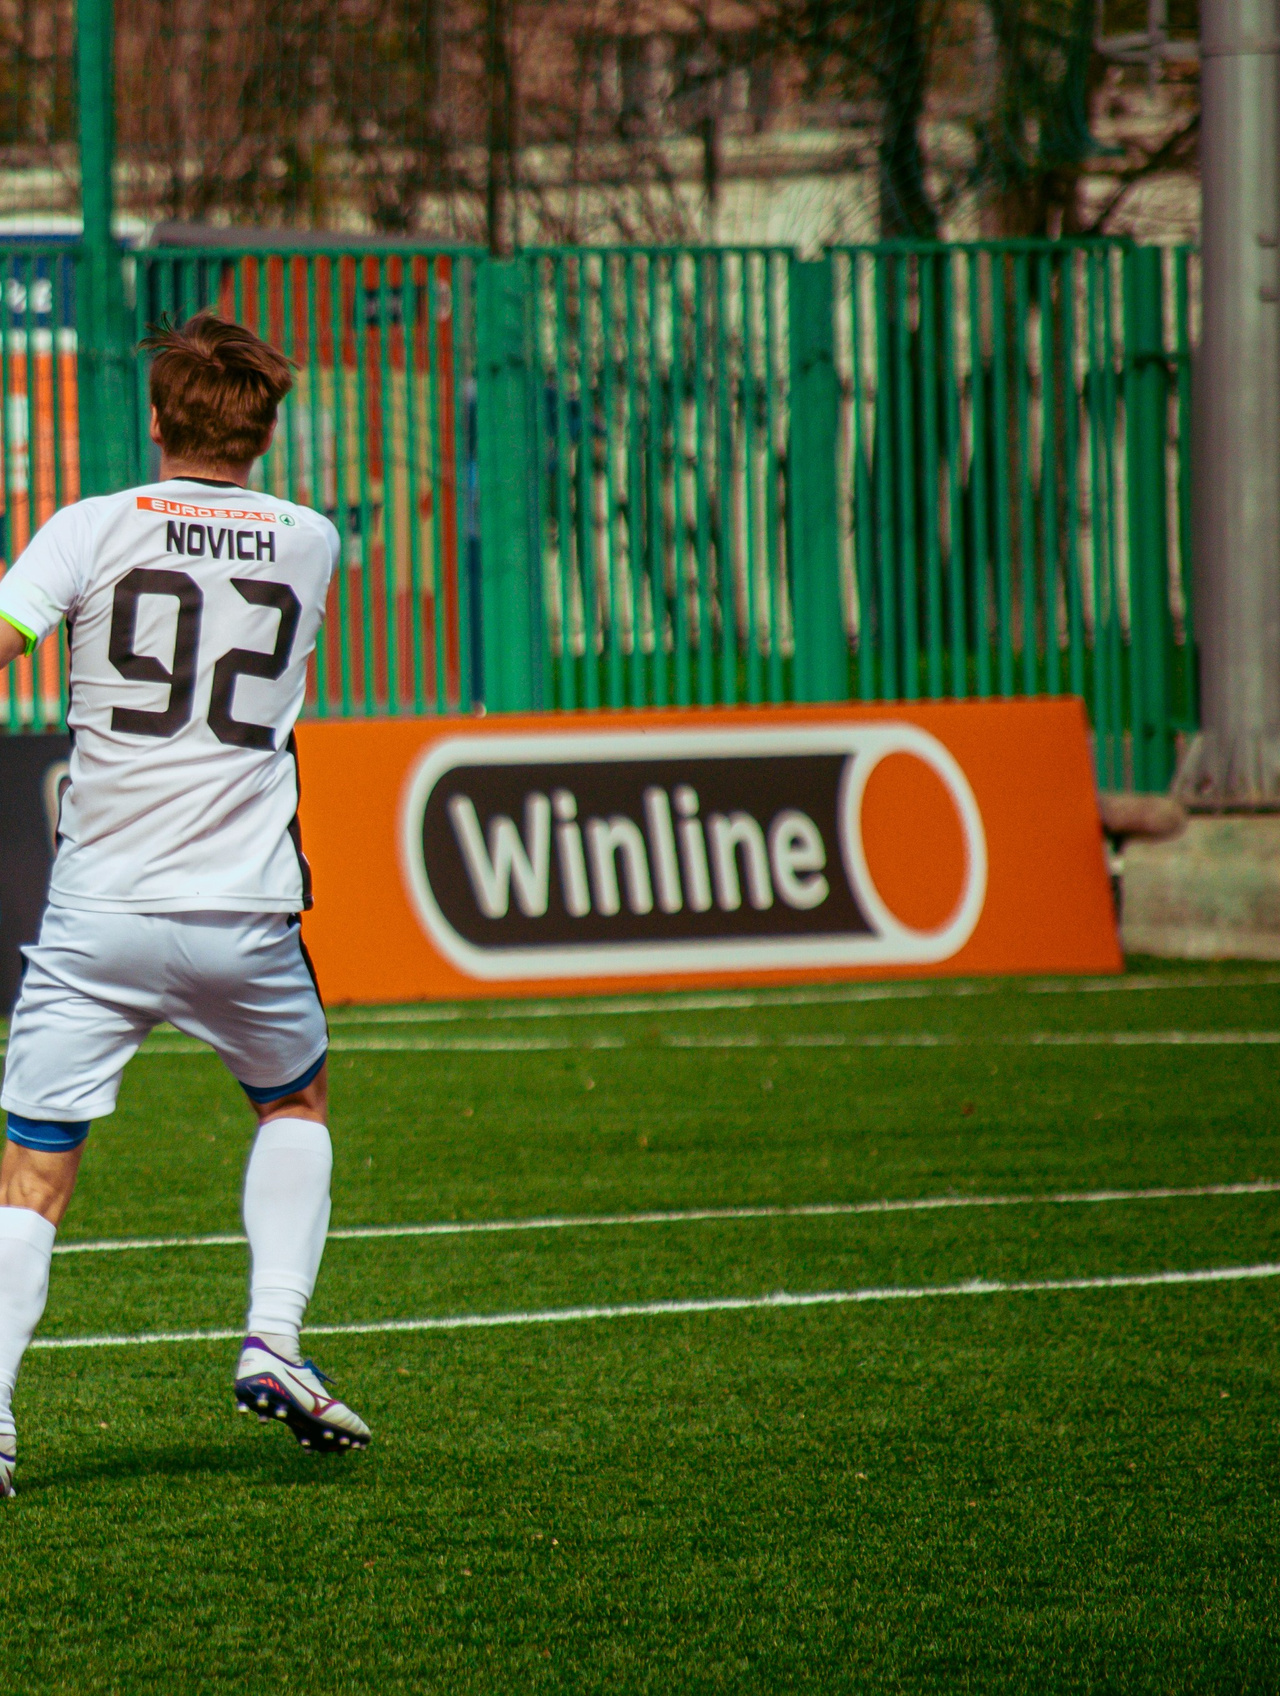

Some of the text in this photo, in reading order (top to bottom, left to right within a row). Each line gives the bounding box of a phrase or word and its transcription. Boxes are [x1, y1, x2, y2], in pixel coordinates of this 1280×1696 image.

[151, 499, 277, 523] EUROSPAR
[166, 520, 277, 562] NOVICH
[108, 567, 303, 752] 92
[450, 784, 830, 920] Winline
